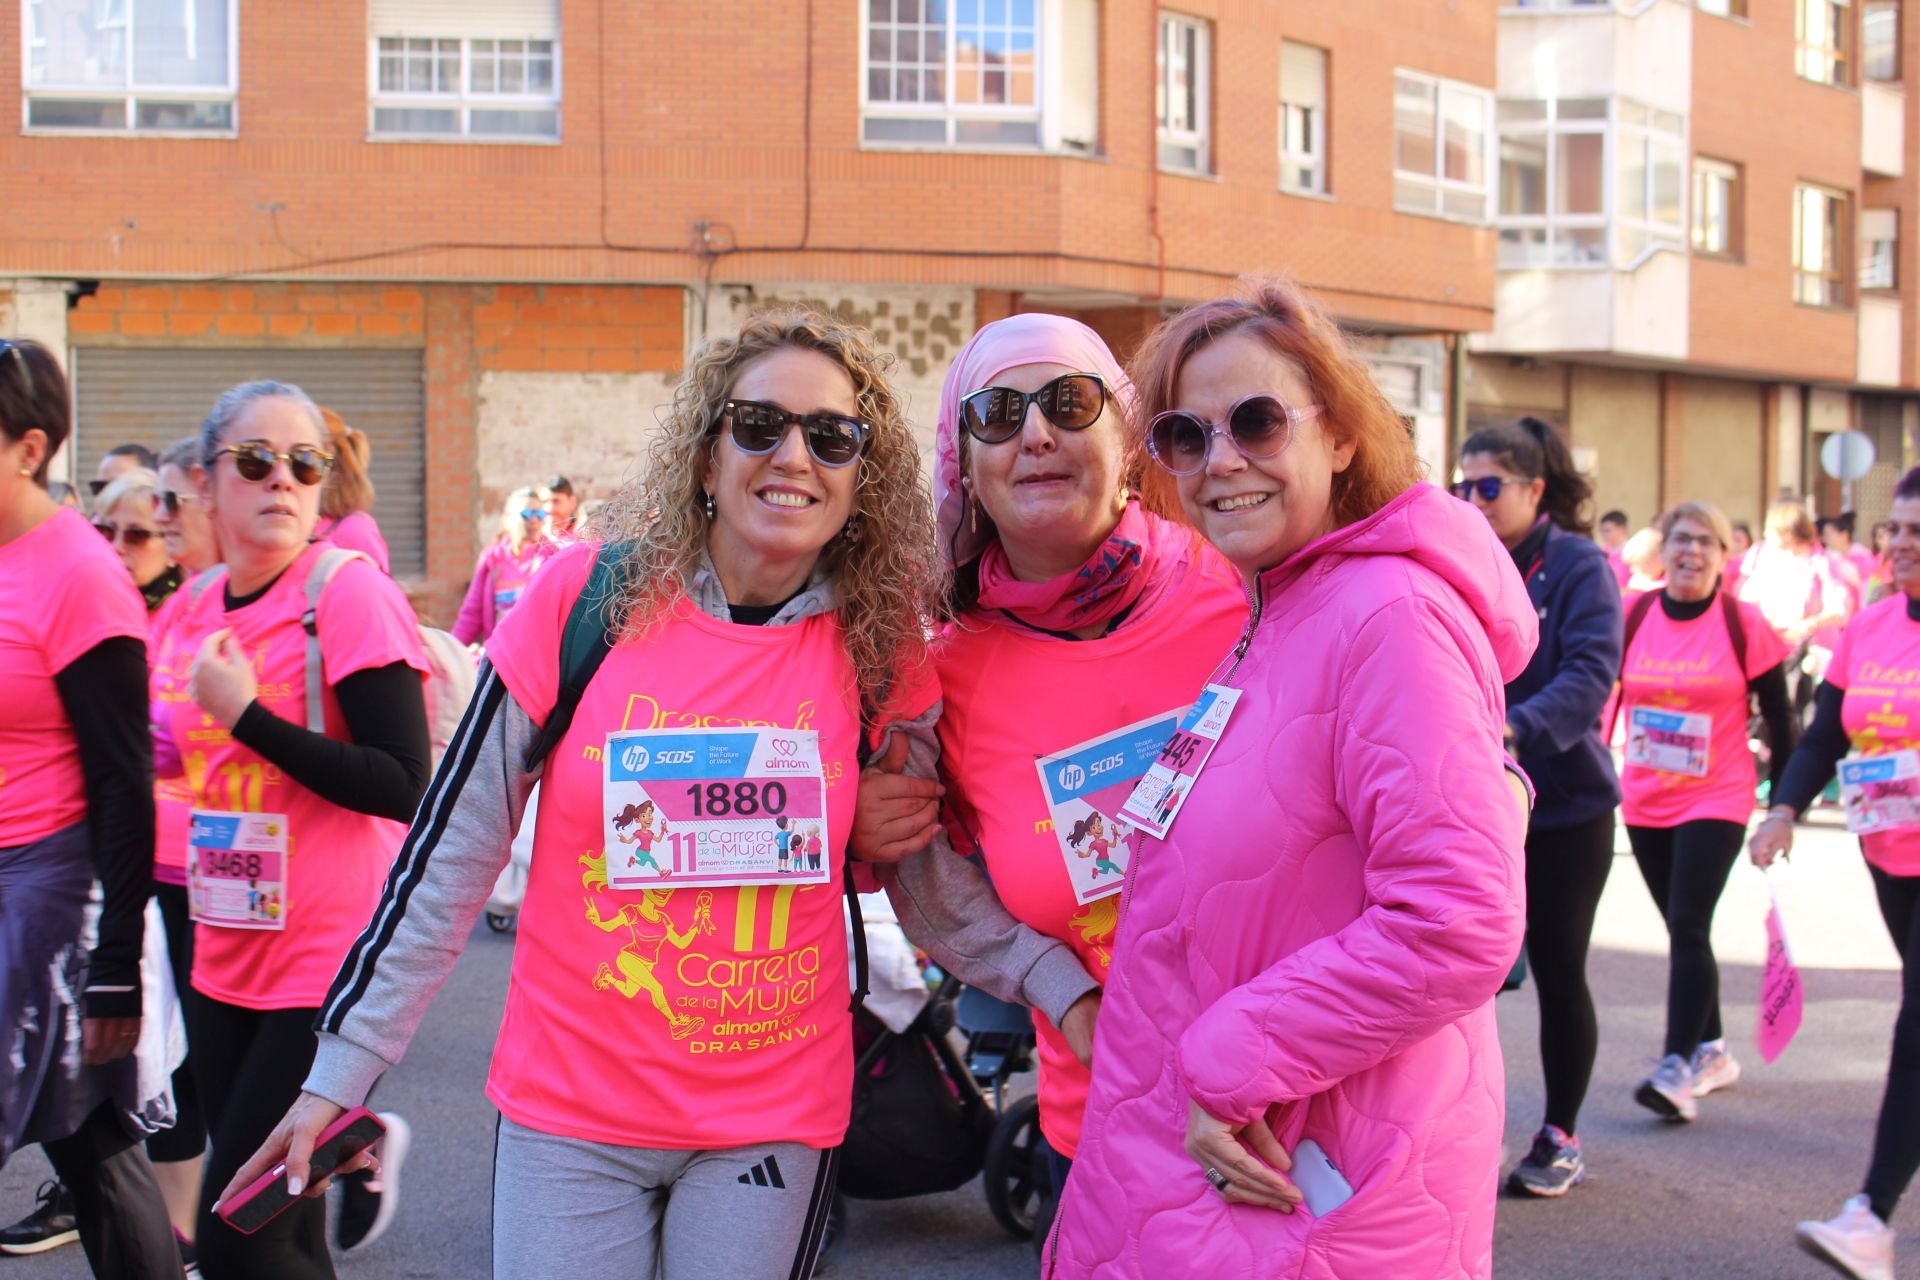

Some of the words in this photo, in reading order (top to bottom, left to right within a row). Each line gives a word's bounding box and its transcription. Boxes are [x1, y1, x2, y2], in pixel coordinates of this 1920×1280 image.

[622, 745, 650, 773] hp
[709, 745, 729, 753] Shape
[765, 757, 810, 769] almom
[1059, 764, 1086, 791] hp
[687, 781, 787, 817] 1880
[708, 829, 774, 844] Carrera
[698, 847, 710, 856] de
[722, 843, 773, 859] Mujer
[677, 945, 820, 988] Carrera
[676, 994, 698, 1008] de
[702, 995, 718, 1009] la
[720, 975, 818, 1017] Mujer
[690, 1023, 818, 1054] DRASANVI
[712, 1020, 779, 1036] almom
